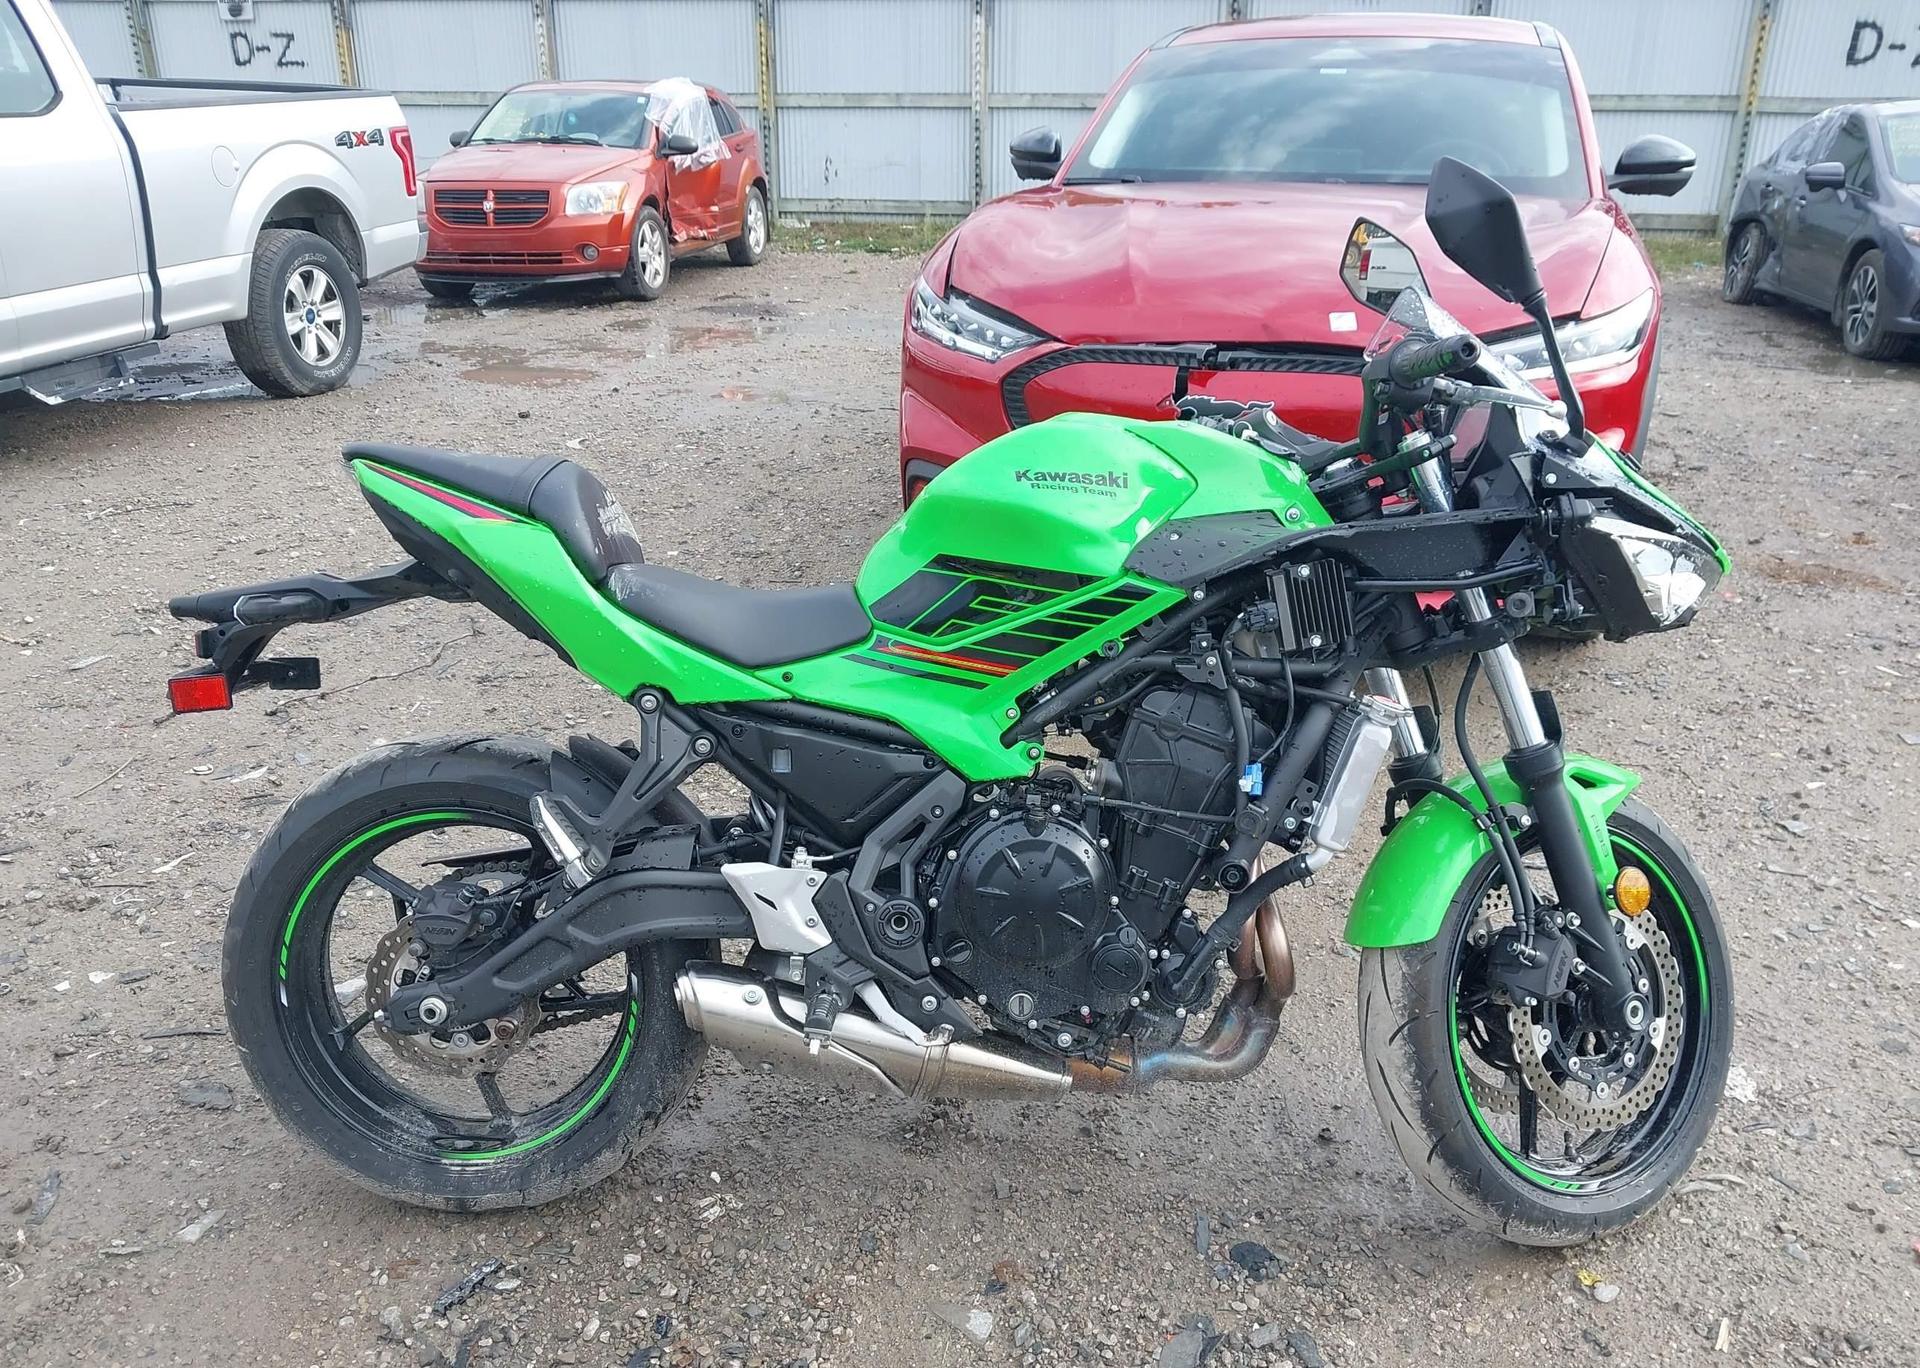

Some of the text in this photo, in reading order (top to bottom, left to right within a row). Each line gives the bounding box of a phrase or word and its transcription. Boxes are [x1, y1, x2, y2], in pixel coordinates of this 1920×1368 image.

[1846, 20, 1920, 68] D-
[1014, 468, 1129, 490] Kawasaki
[1030, 482, 1117, 499] Racing Team
